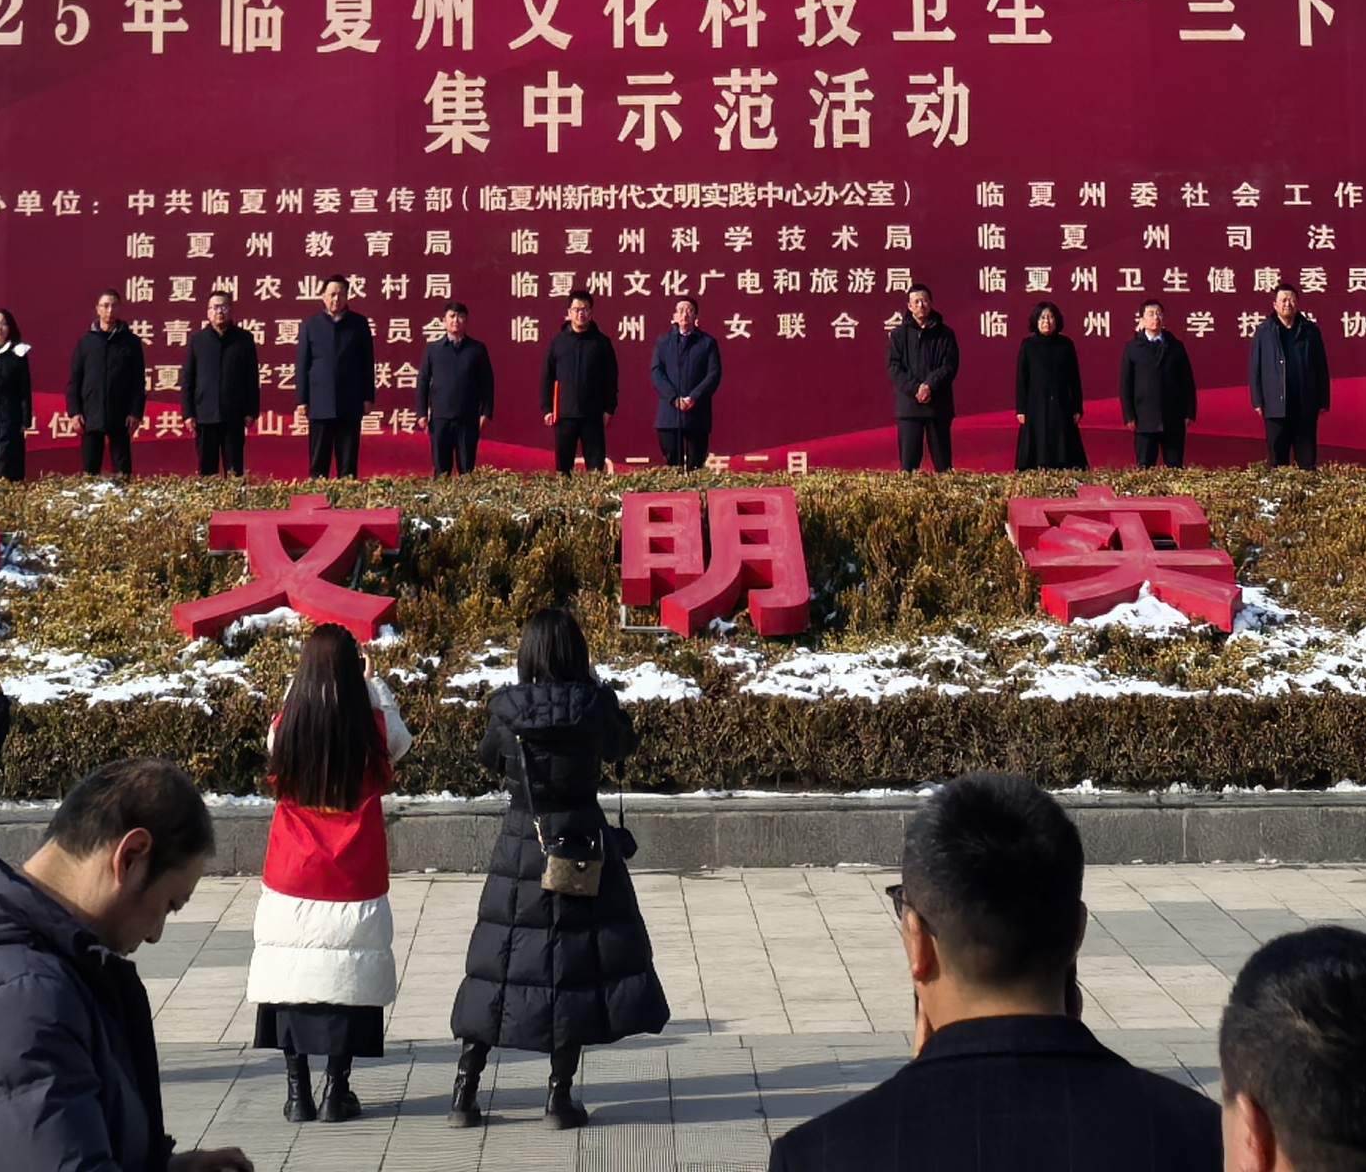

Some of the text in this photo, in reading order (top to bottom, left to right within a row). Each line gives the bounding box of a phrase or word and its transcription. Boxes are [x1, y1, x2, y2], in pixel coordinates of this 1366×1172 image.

[425, 66, 970, 153] 集中示范活动
[126, 230, 452, 259] 临夏州教育局
[511, 225, 913, 255] 临夏州科学技术局
[126, 273, 452, 303] 临夏州农业农村局
[511, 268, 912, 298] 临夏州文化广电和旅游局
[129, 317, 450, 347] 共青临夏员会
[511, 312, 903, 343] 临州女联合
